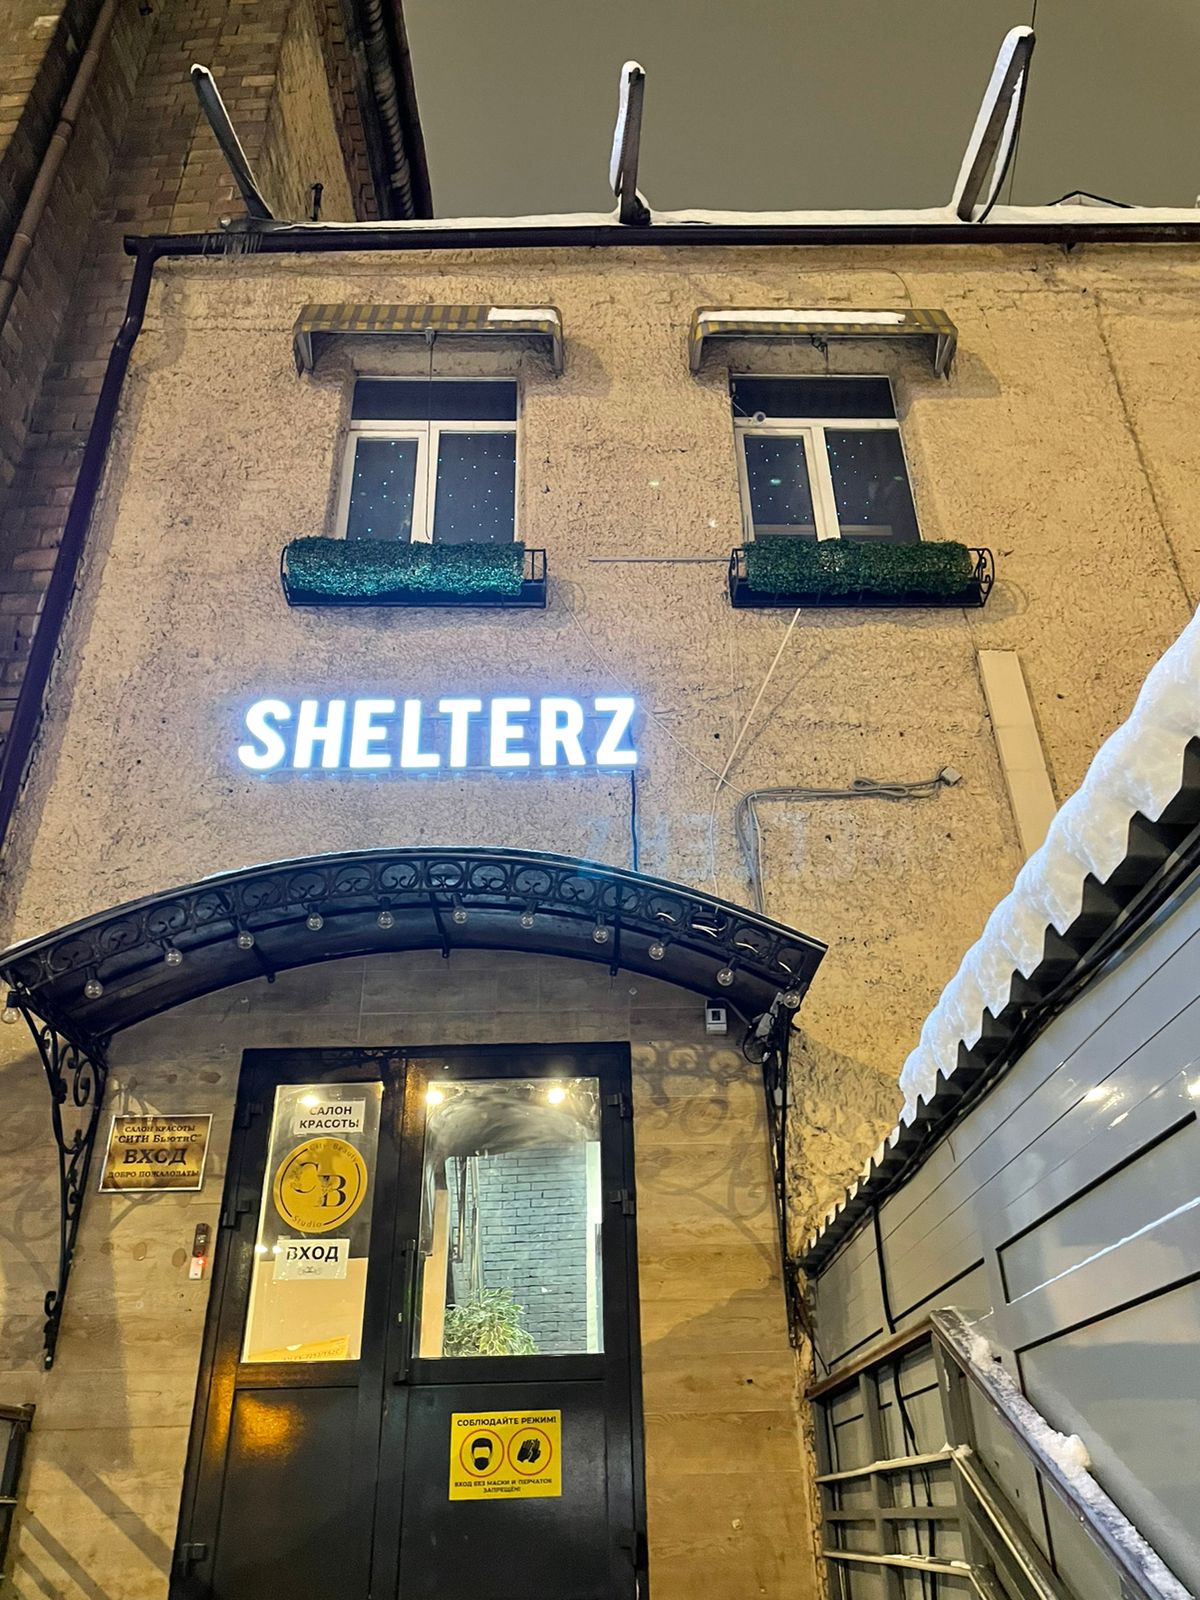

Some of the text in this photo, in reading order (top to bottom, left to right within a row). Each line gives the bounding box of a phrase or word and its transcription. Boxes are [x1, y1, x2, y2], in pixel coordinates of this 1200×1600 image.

[237, 697, 638, 769] SHELTERZ
[309, 1105, 353, 1116] САЛОН
[124, 1124, 196, 1133] САЛОН КРАСОТЫ
[299, 1119, 359, 1129] КРАСОТЫ
[122, 1148, 188, 1166] ВХОД
[107, 1170, 137, 1178] ДОБРО
[291, 1215, 323, 1228] Studio
[286, 1246, 339, 1263] ВХОД
[457, 1416, 557, 1426] СОБЛЮДАЙТЕ РЕЖИМ!
